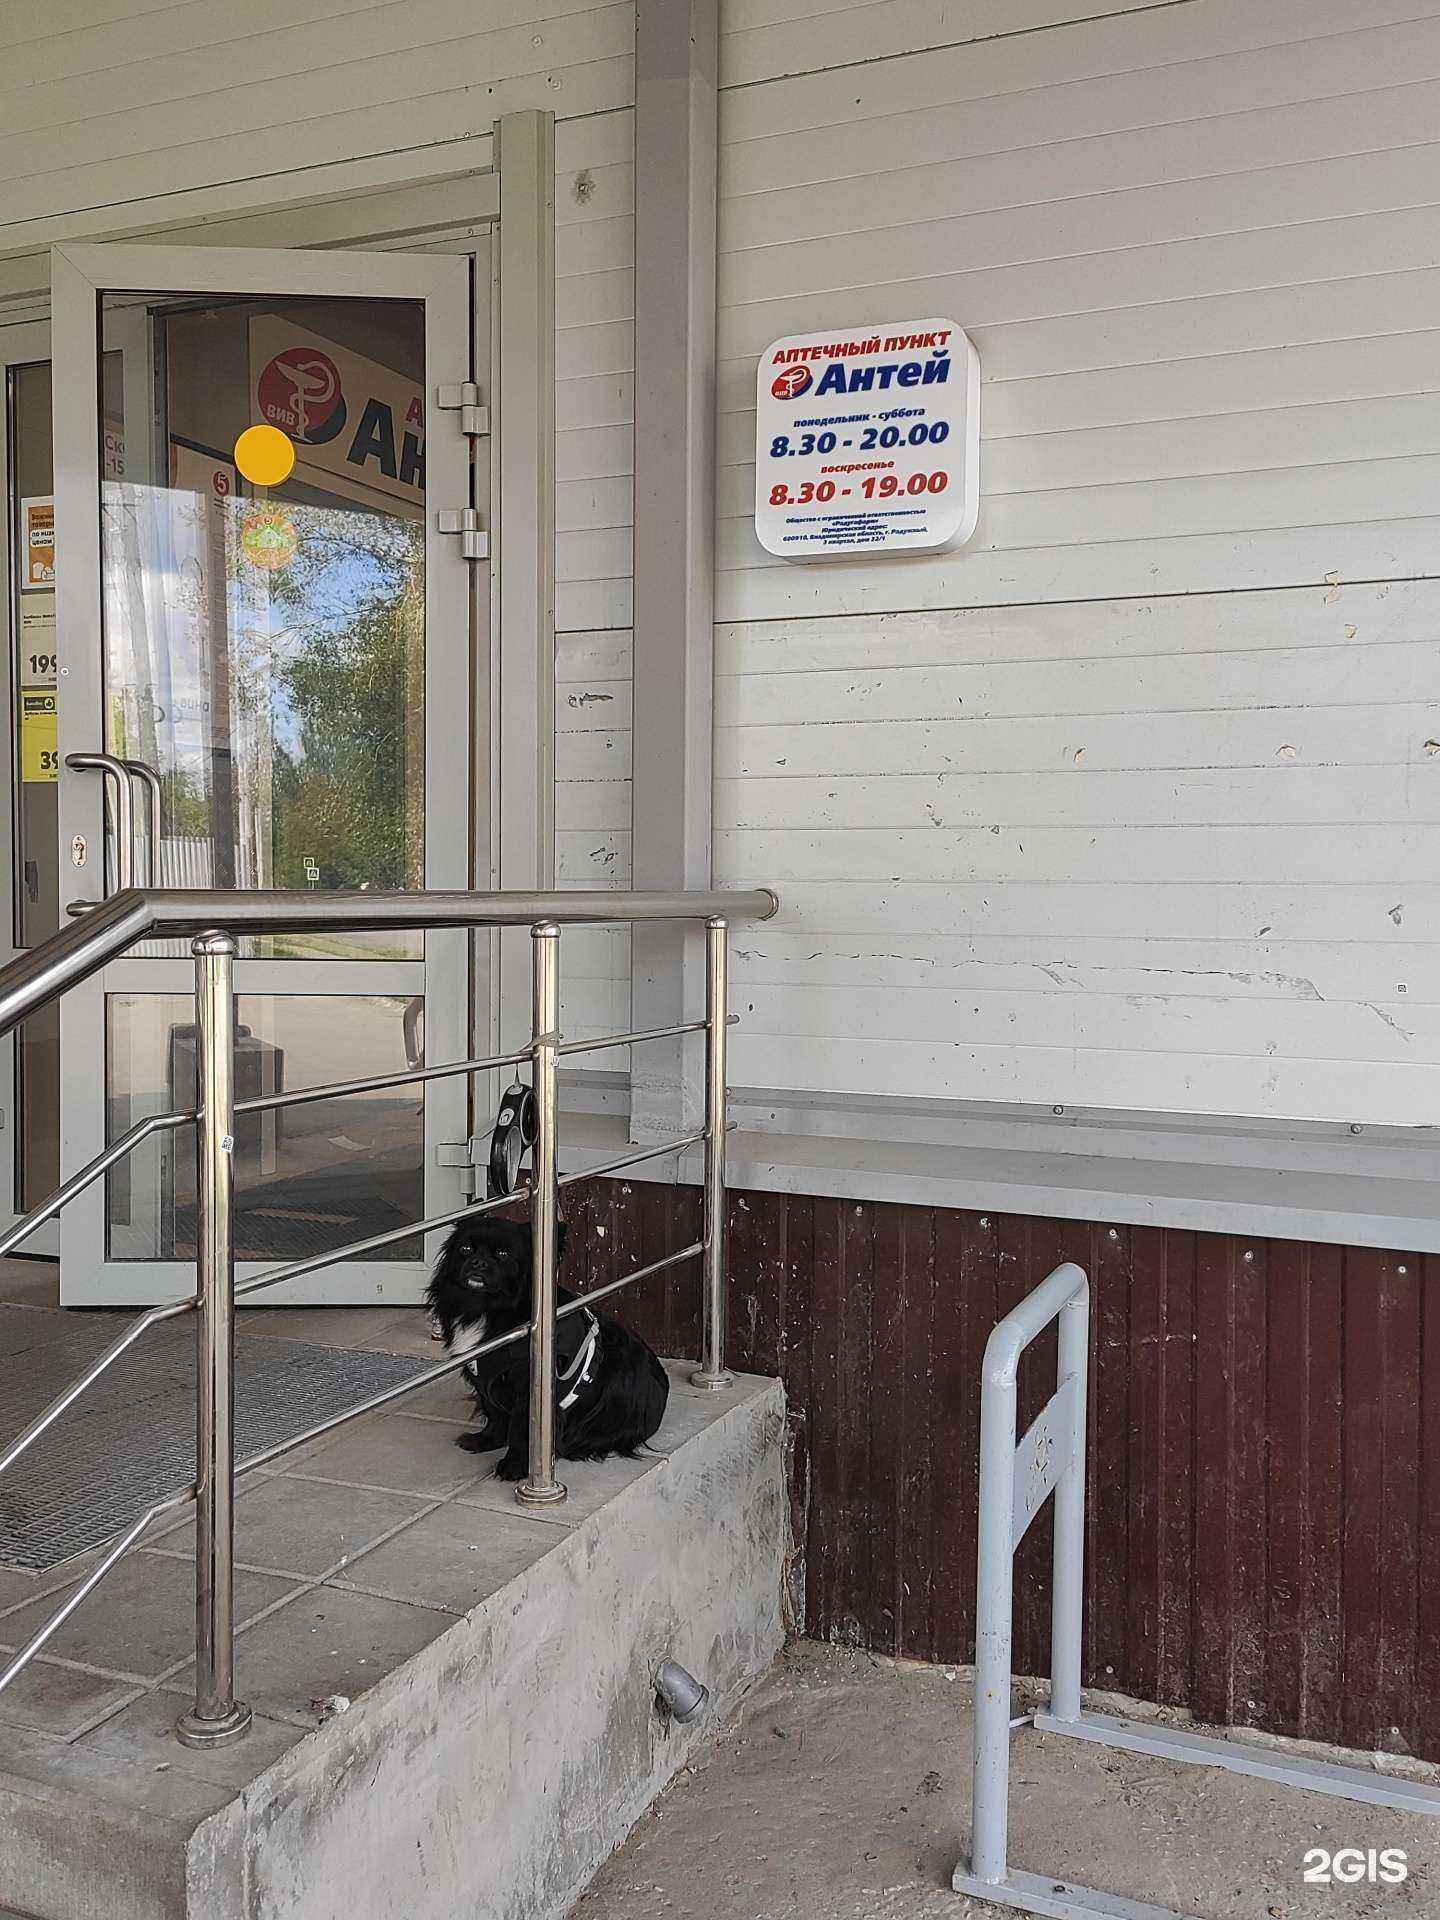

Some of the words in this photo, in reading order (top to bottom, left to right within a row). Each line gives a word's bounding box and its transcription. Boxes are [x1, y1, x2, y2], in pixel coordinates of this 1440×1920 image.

[772, 336, 881, 364] АПТЕЧНЫЙ
[883, 331, 951, 352] ПУНКТ
[814, 350, 951, 396] Антей
[267, 404, 296, 426] ВИВ
[793, 413, 869, 428] понедельник
[878, 407, 925, 422] суббота
[770, 432, 836, 457] 8.30
[859, 421, 950, 450] 20.00
[820, 460, 894, 474] воскресенье
[769, 481, 836, 505] 8.30
[861, 471, 948, 499] 19.00
